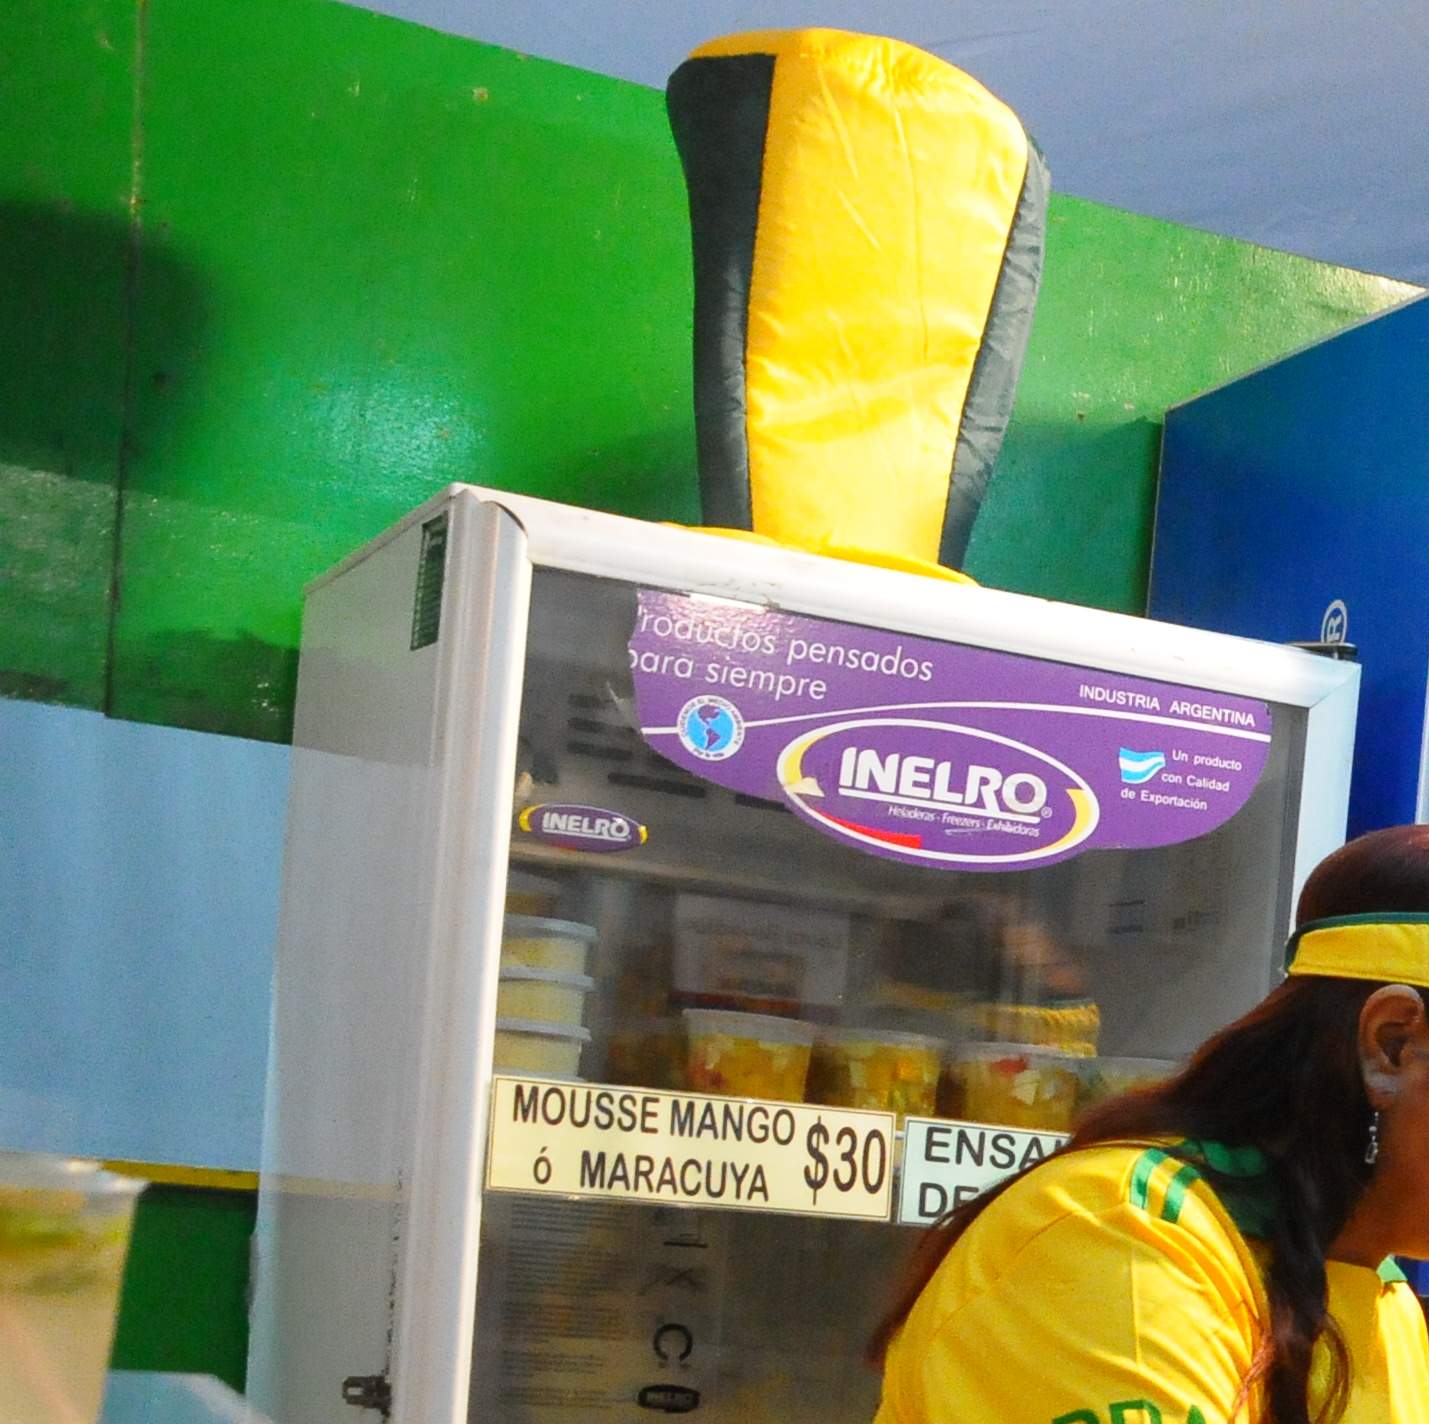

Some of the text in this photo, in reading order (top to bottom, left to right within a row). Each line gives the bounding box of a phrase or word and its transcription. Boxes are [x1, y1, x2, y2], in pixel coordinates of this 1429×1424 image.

[638, 604, 934, 681] roductos pensados
[705, 653, 827, 701] siempre
[1079, 684, 1255, 727] INDUSTRIA ARGENTINA
[839, 746, 1048, 815] INELRO
[1161, 772, 1230, 792] con Calidad
[1172, 750, 1242, 772] Un producto
[1121, 787, 1208, 811] de Exportación
[542, 811, 631, 839] INELRO
[512, 1084, 887, 1206] MOUSSE MANGO $30
[924, 1126, 1067, 1171] ENSA
[532, 1148, 769, 1203] ó MARACUYA
